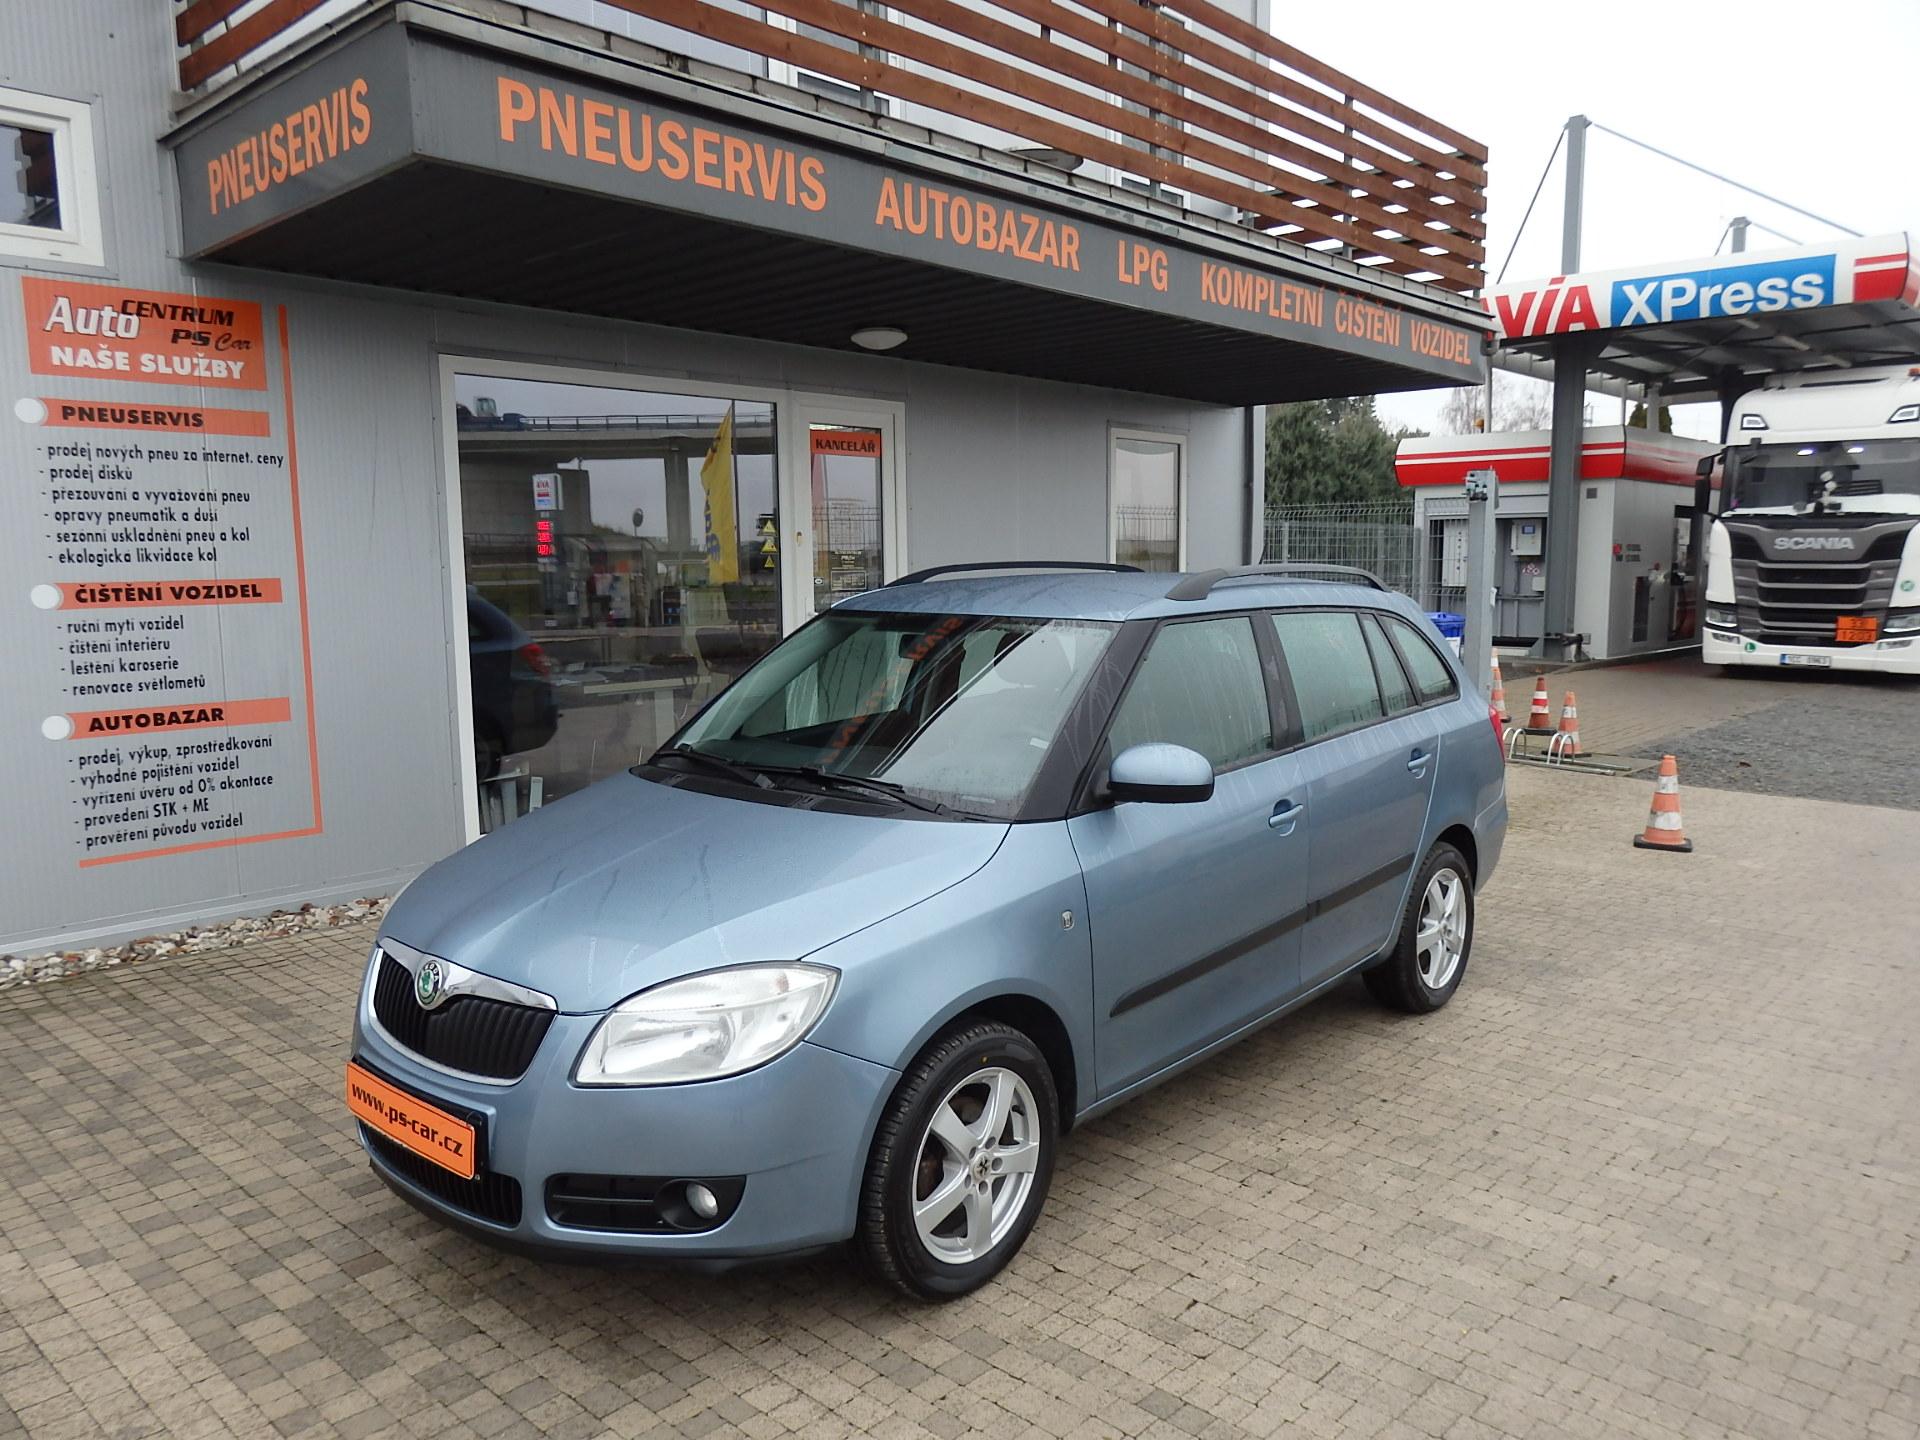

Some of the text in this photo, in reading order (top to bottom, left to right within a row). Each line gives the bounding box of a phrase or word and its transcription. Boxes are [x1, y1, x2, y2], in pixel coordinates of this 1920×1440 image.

[208, 77, 371, 215] PNEUSERVIS
[498, 76, 1472, 365] PNEUSERVIS AUTOBAZAR LPG KOMPLETNÍ ČIŠTĚNÍ VOZIDEL
[1621, 272, 1825, 327] XPress
[43, 295, 234, 339] Auto CENTRUM
[171, 328, 212, 347] PS
[51, 343, 245, 380] NAŠE SLUŽBY
[62, 405, 204, 428] PNEUSERVIS
[48, 442, 284, 468] prodej nových pneu za internet. ceny
[50, 464, 133, 483] prodej disků
[52, 487, 250, 506] přezouvání a vyvažování pneu
[55, 507, 218, 525] opravy pneumatik a duší
[57, 526, 250, 545] sezónní uskladnění pneu a kol
[1773, 537, 1855, 550] SCANIA
[59, 546, 217, 567] ekologická likvidace kol
[75, 582, 262, 603] ČIŠTĚNÍ VOZIDEL
[67, 619, 100, 633] ruční
[140, 614, 184, 630] vozidel
[70, 636, 170, 654] čištění interiéru
[71, 655, 179, 675] leštění karoserie
[73, 673, 206, 696] renovace světlometů
[89, 707, 225, 733] AUTOBAZAR
[129, 744, 171, 764] výkup,
[176, 734, 273, 759] zprostředkování
[81, 755, 239, 790] výhodné pojištění vozidel
[83, 775, 273, 810] vyřízení úvěru od 0% akontace
[85, 806, 149, 831] provedení
[153, 801, 177, 818] STK
[193, 798, 209, 813] ME
[86, 812, 243, 851] prověření původu vozidel
[352, 1083, 464, 1158] www.ps-car.cz
